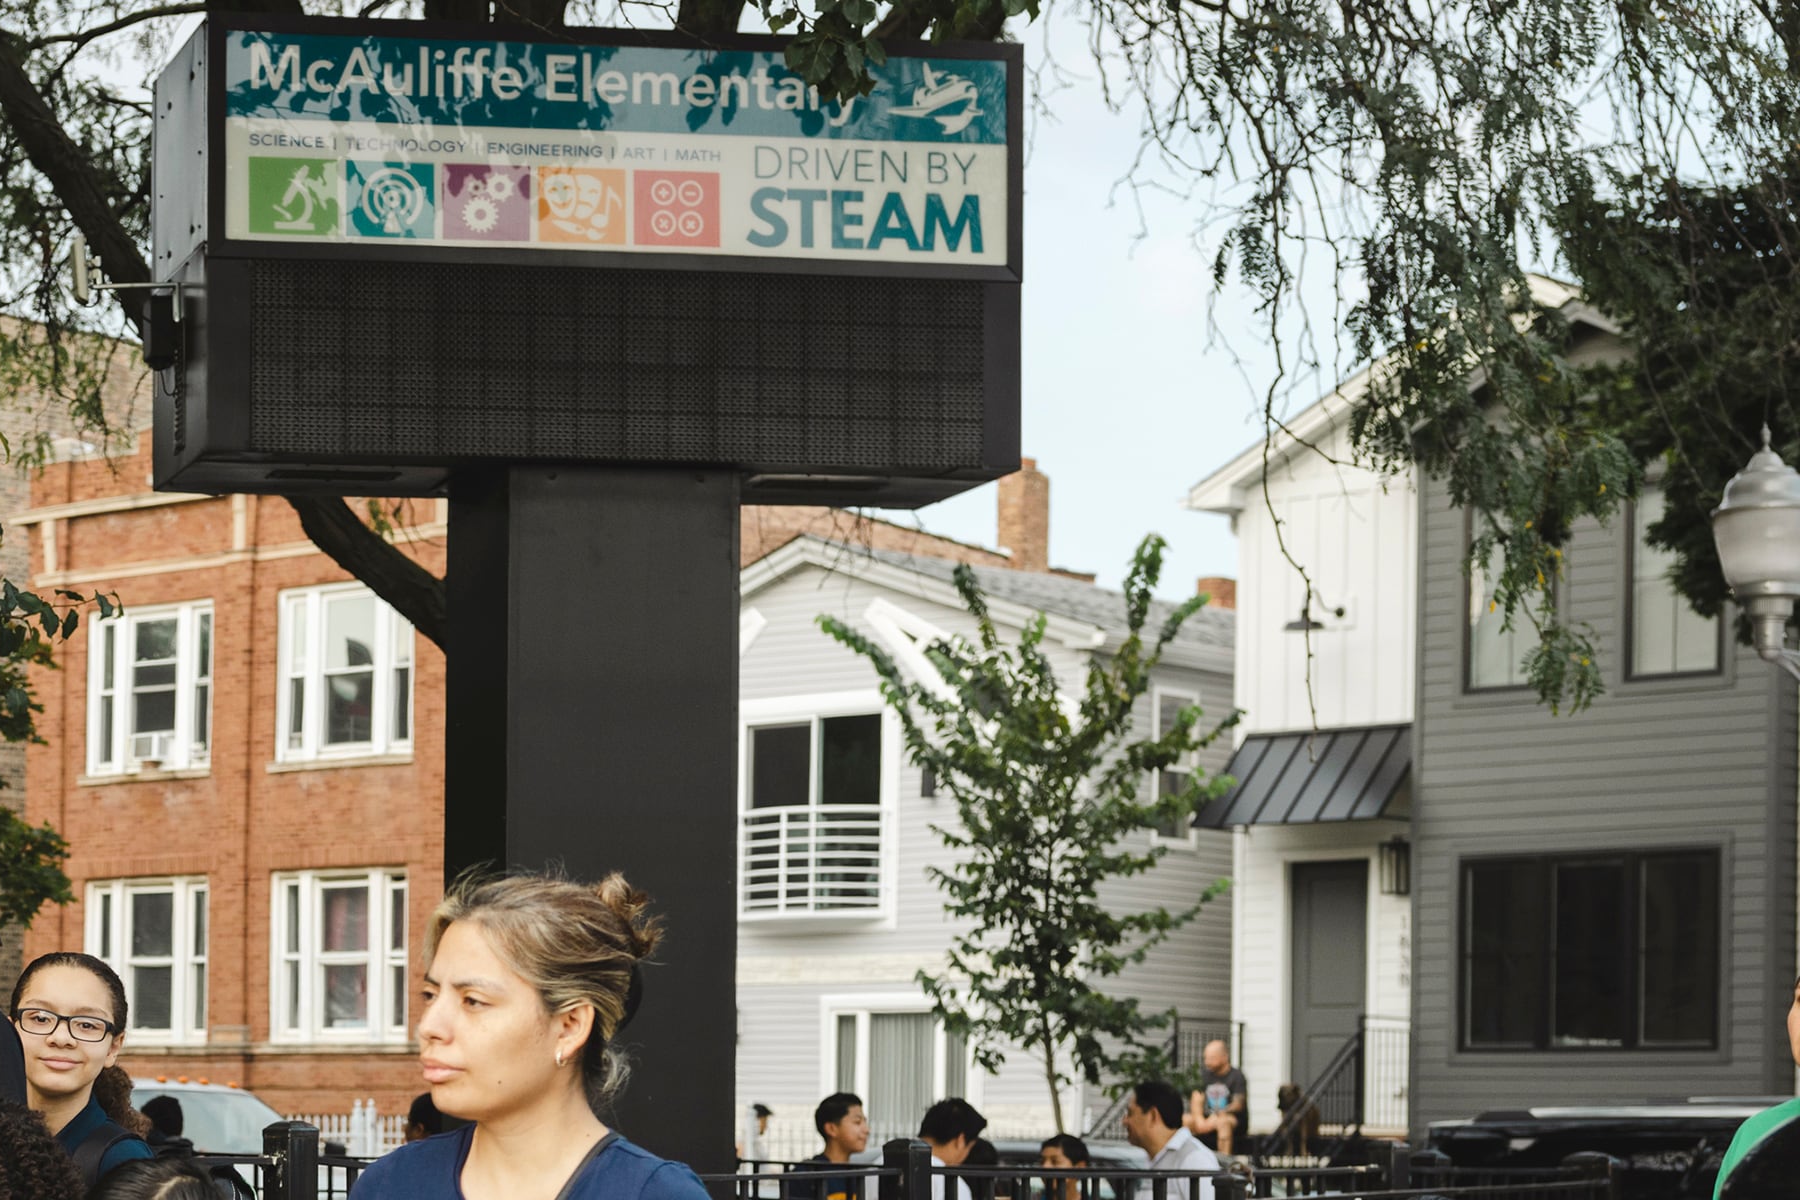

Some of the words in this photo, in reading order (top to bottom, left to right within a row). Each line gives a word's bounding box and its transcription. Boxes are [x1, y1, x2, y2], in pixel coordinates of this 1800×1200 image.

[249, 42, 523, 101] McAuliffe
[249, 133, 325, 149] SCIENCE
[345, 137, 467, 153] TECHNOLOGY
[487, 142, 603, 158] ENGINEERING
[623, 147, 656, 160] ART
[675, 149, 721, 162] MATH
[754, 145, 907, 184] DRIVEN
[927, 151, 977, 185] BY
[746, 186, 984, 254] STEAM
